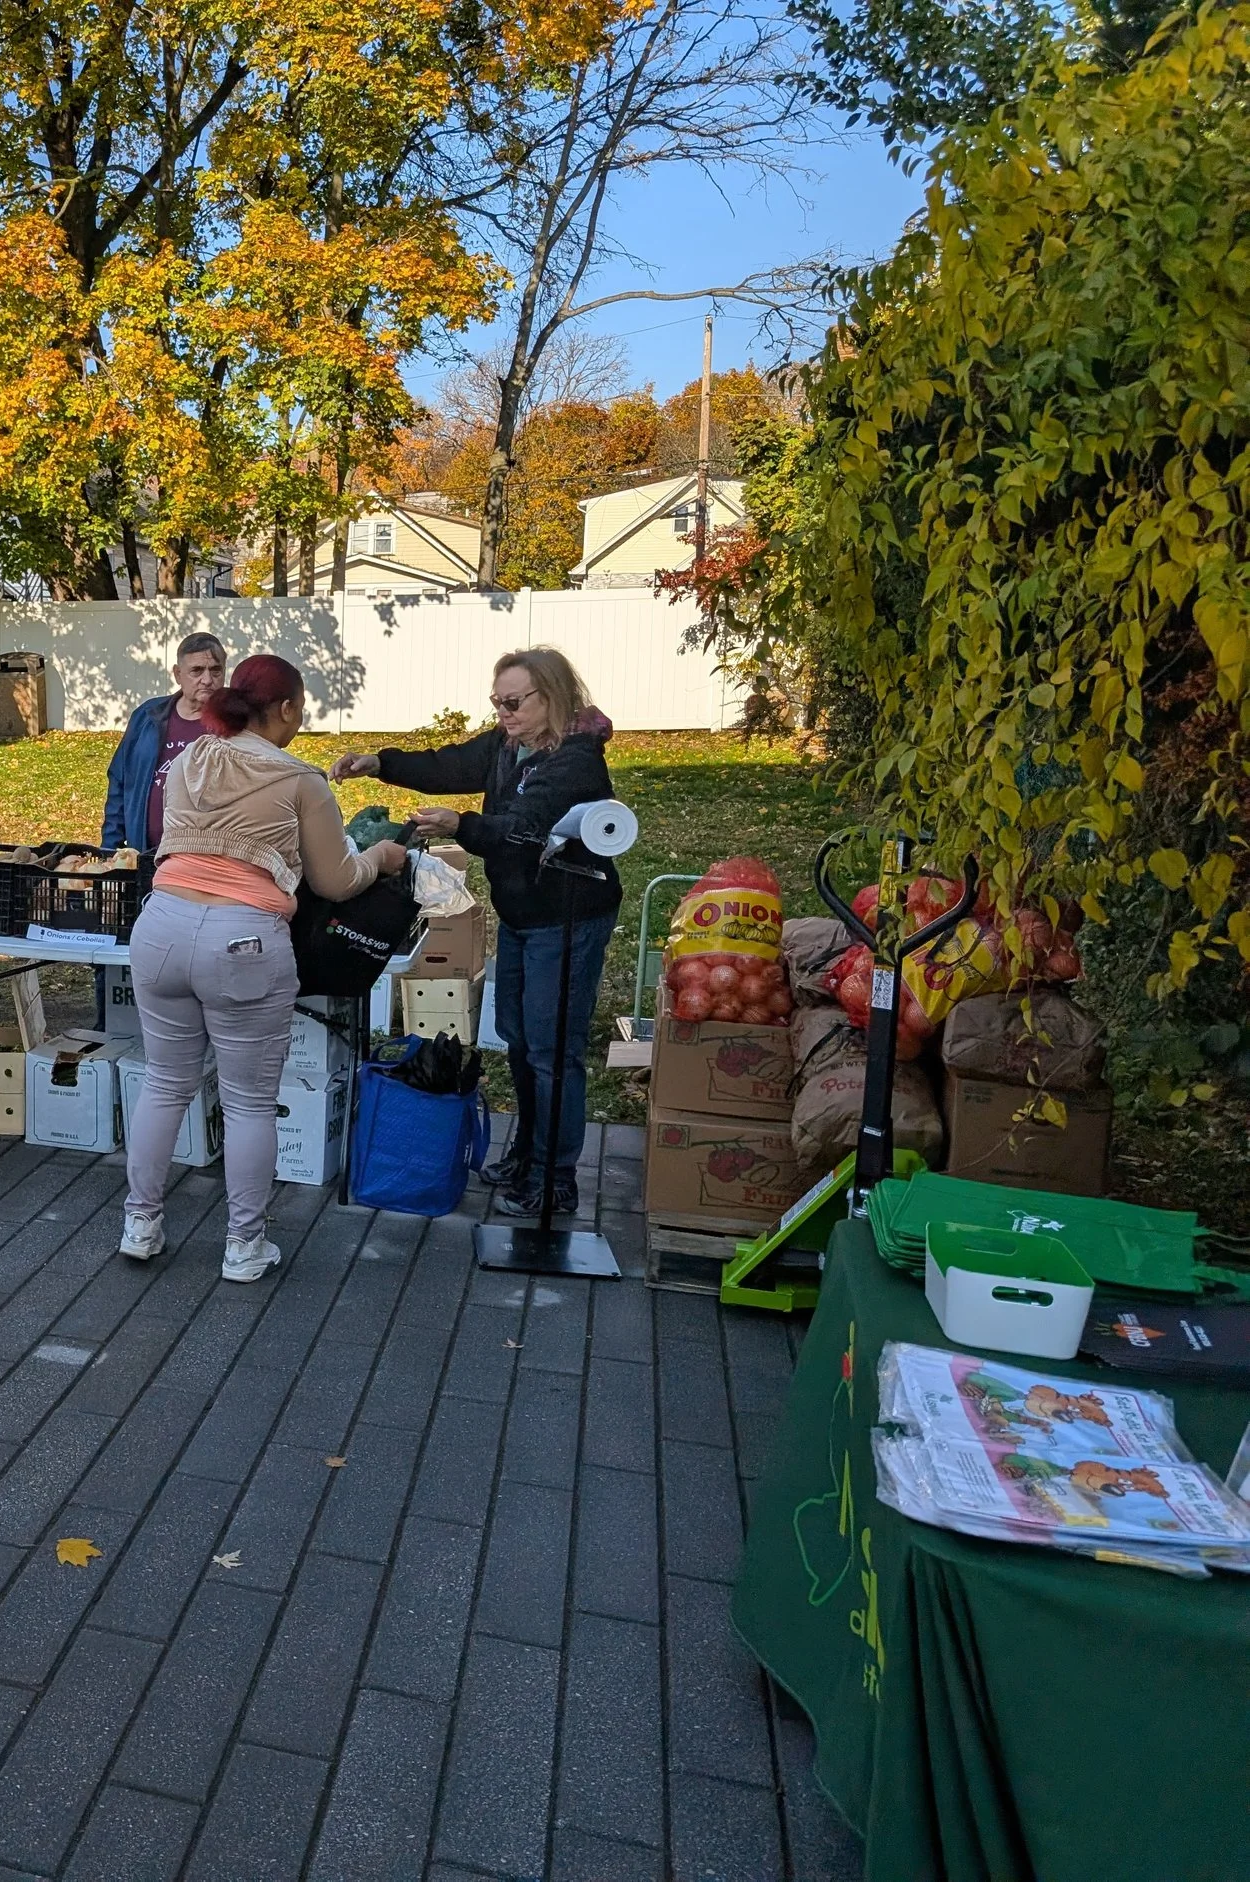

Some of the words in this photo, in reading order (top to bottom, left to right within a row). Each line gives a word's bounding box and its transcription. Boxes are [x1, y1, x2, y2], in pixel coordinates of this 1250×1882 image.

[46, 931, 70, 940] Onions
[76, 935, 106, 944] Cebollas
[335, 924, 390, 951] STOP&SHOP
[281, 1156, 304, 1165] Farms
